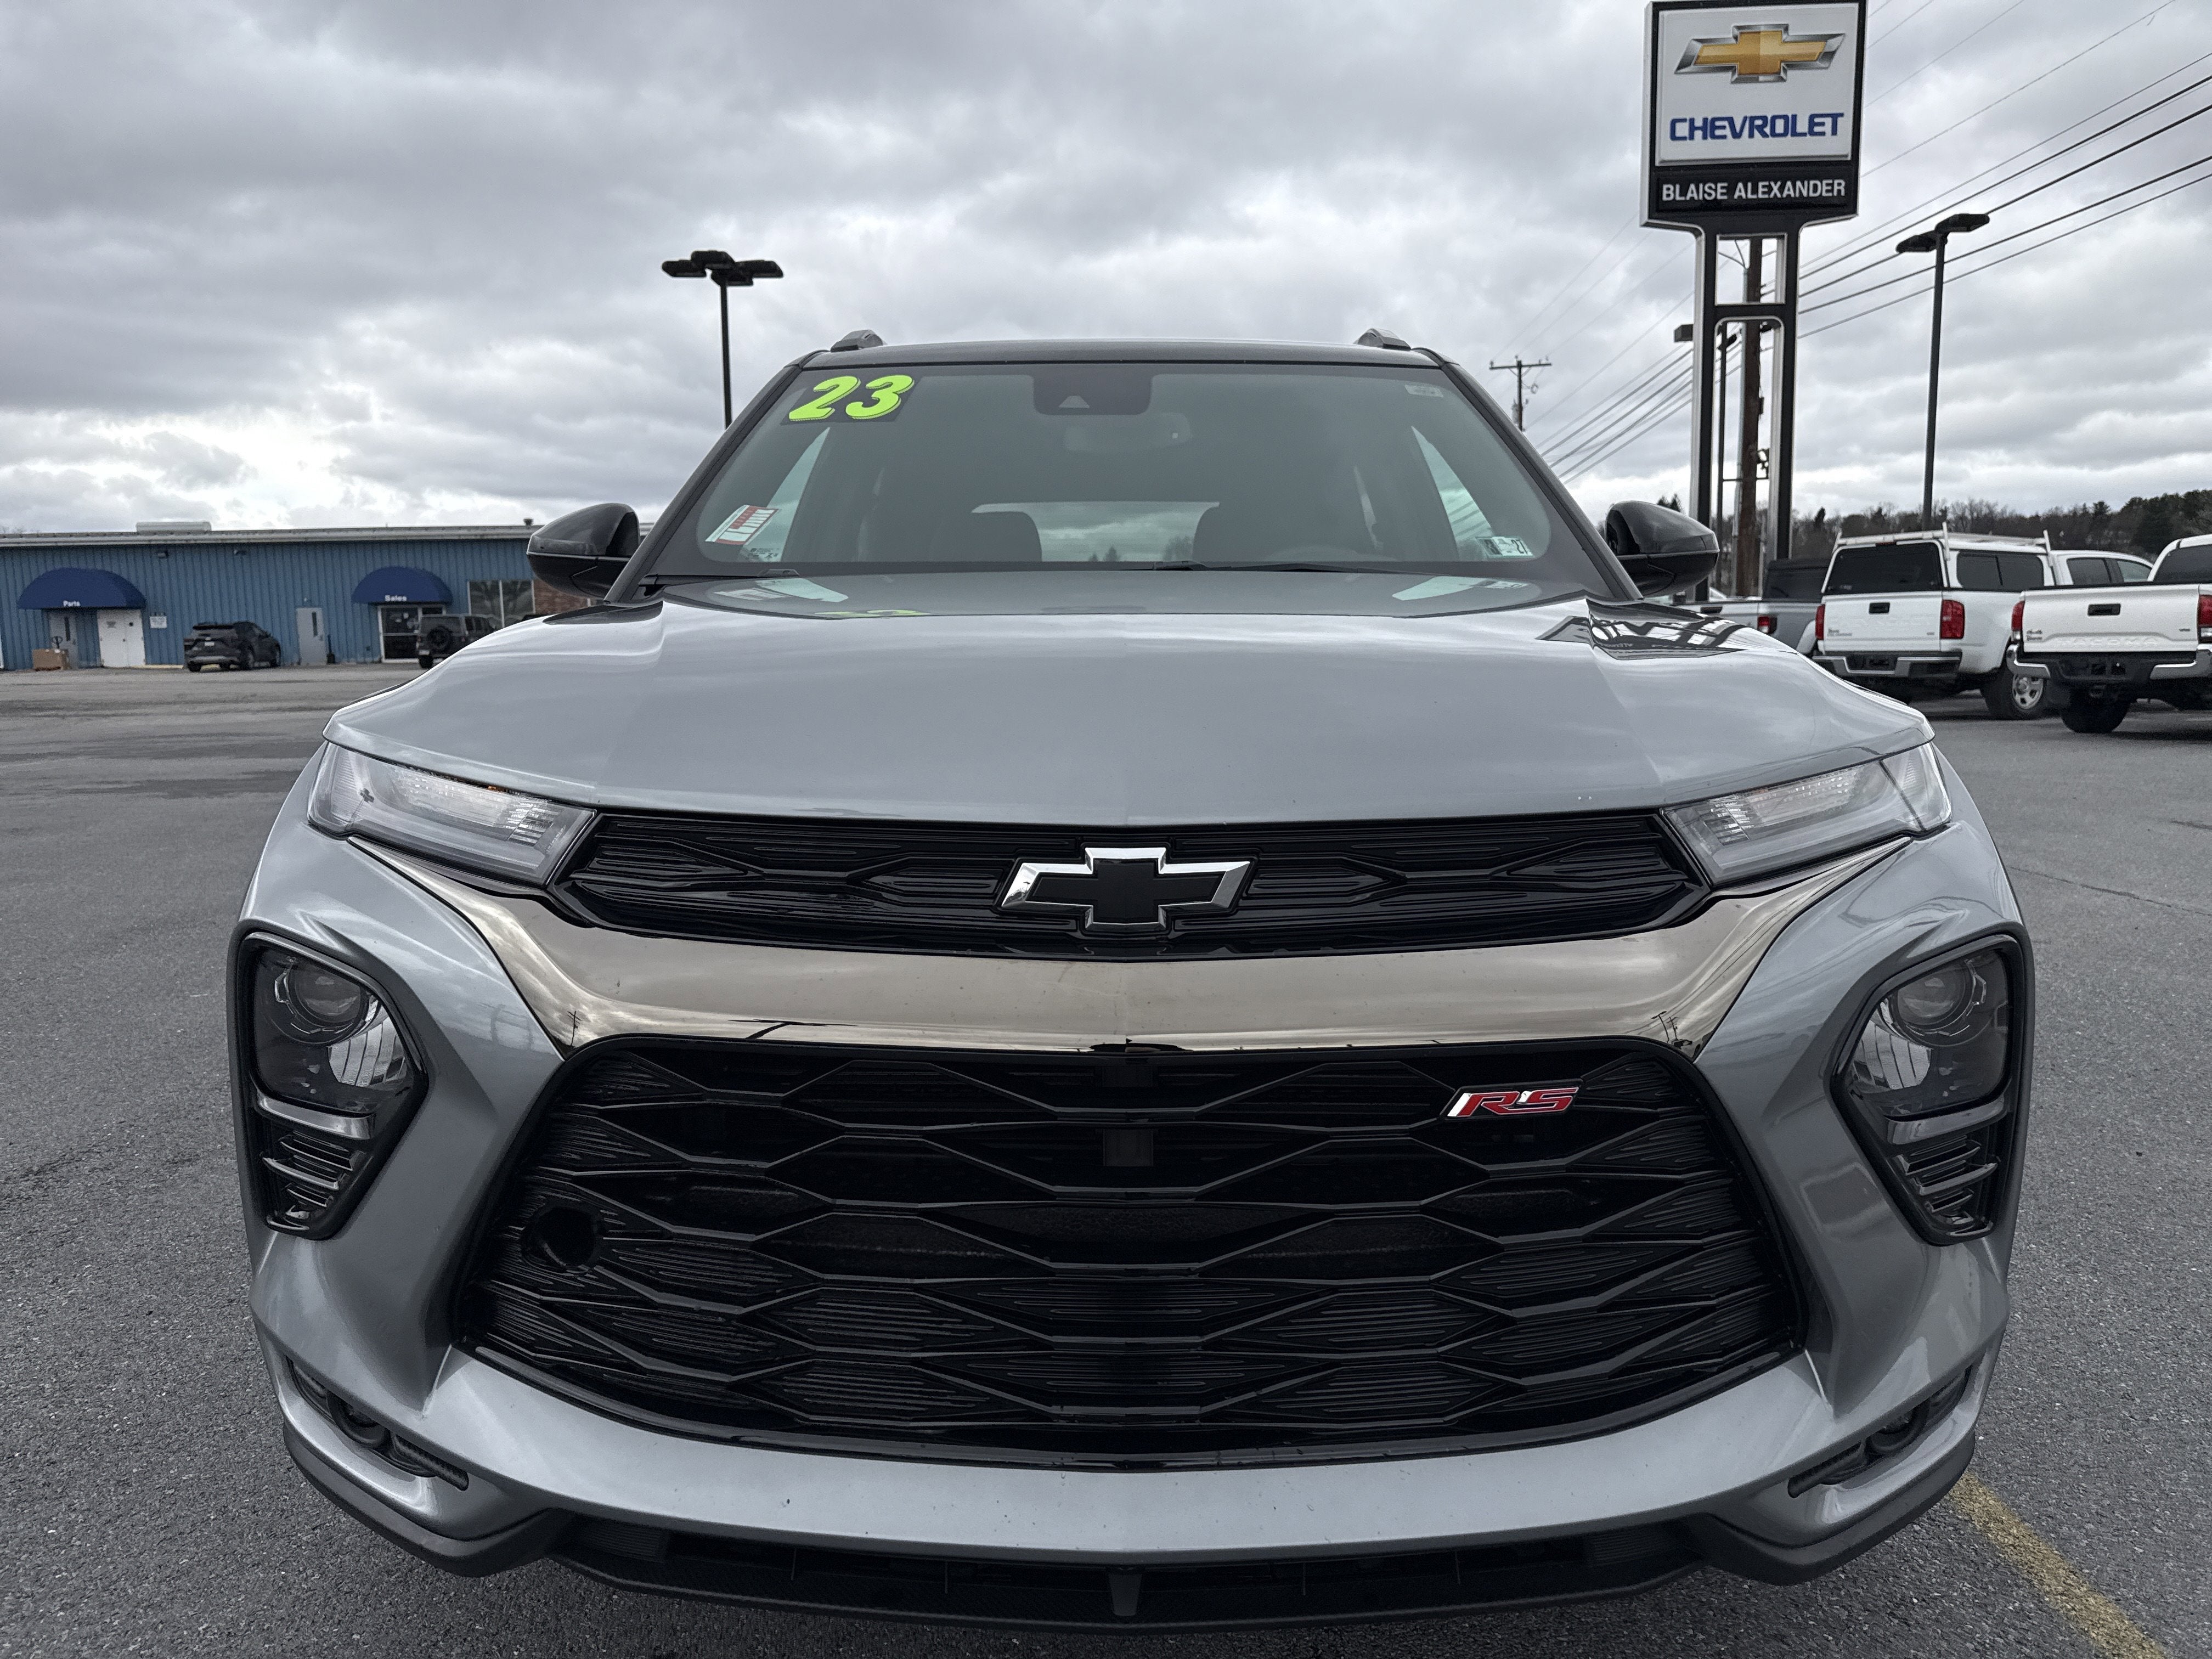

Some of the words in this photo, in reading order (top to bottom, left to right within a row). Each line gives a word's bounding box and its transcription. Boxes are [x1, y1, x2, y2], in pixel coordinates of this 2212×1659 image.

[1669, 112, 1844, 141] CHEVROLET
[1662, 183, 1728, 201] BLAISE
[1734, 179, 1846, 199] ALEXANDER
[789, 375, 915, 421] 23
[1447, 1087, 1579, 1117] RS
